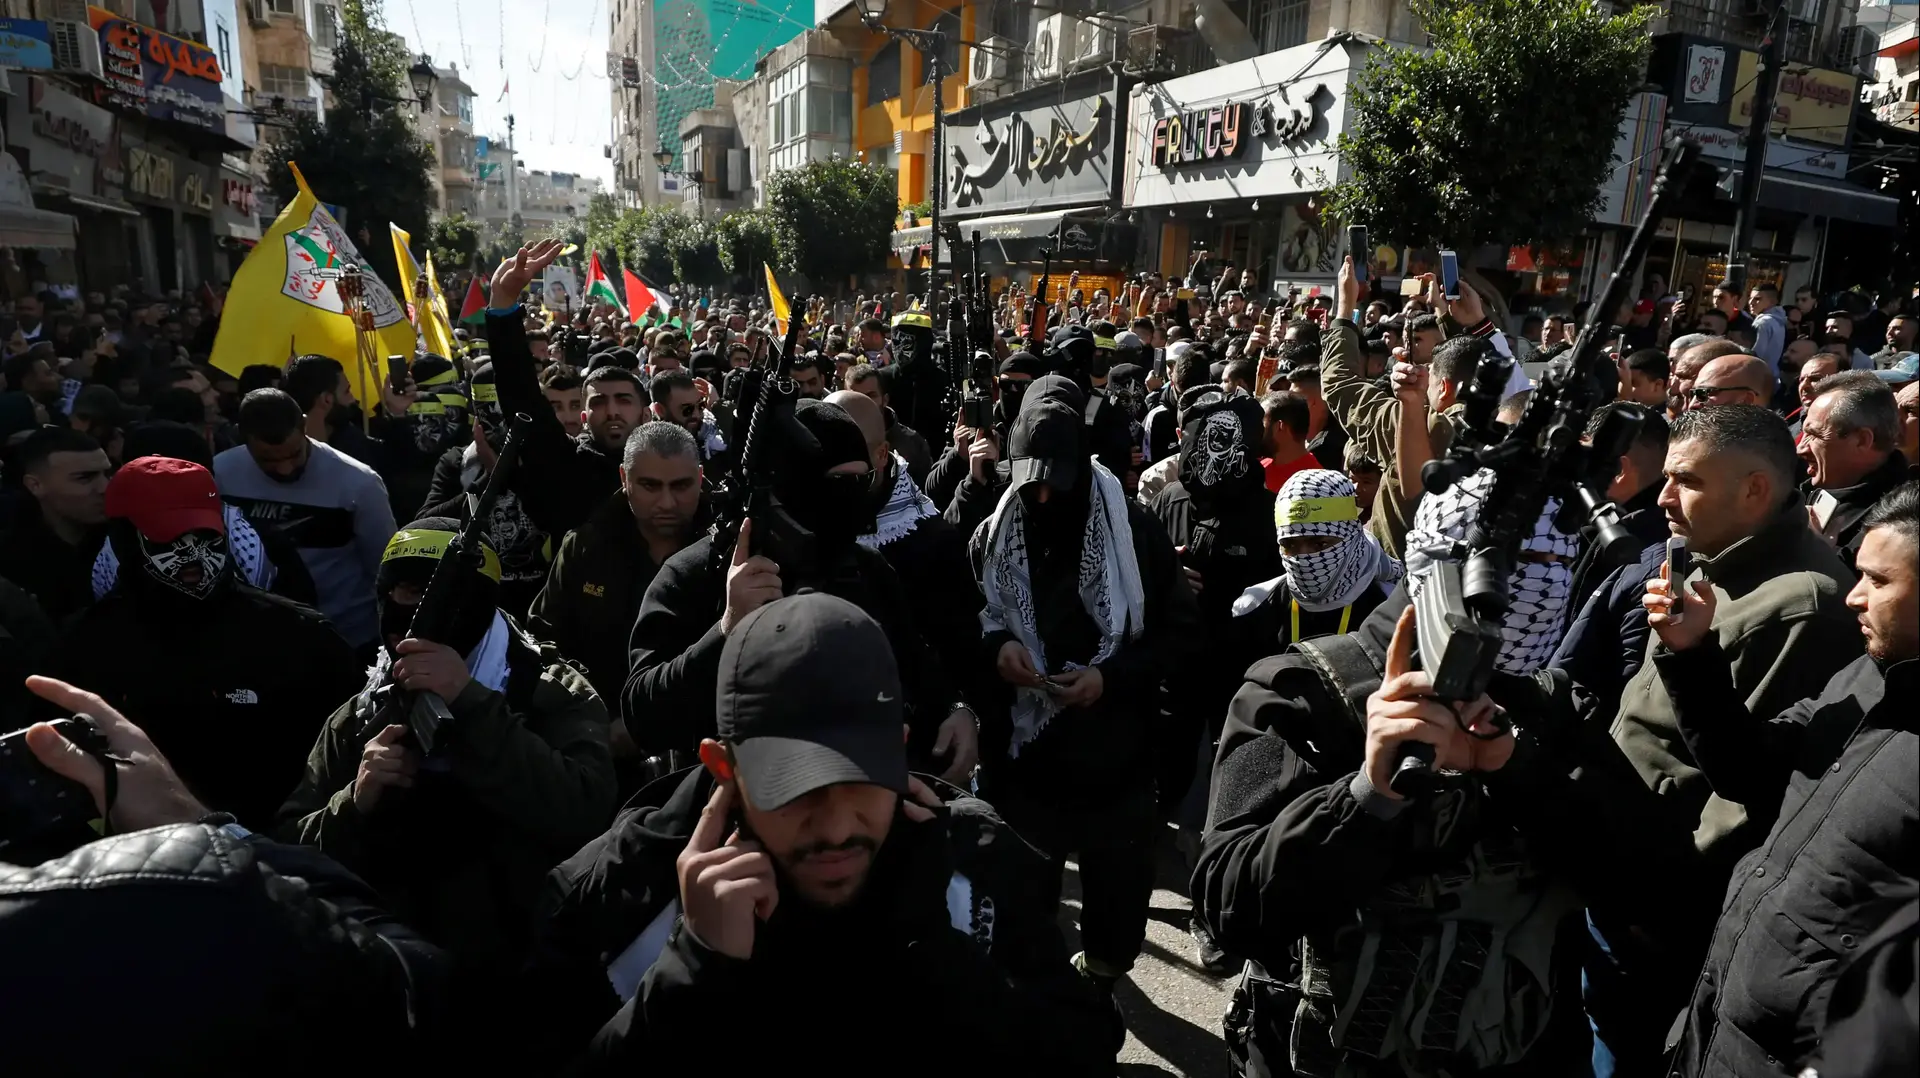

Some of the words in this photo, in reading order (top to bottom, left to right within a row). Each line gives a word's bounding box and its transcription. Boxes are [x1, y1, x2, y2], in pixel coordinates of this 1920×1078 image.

[1251, 107, 1266, 137] &
[1028, 94, 1102, 171] مجوهرات
[249, 501, 293, 520] NIKE
[390, 546, 402, 556] الله
[403, 546, 417, 556] رام
